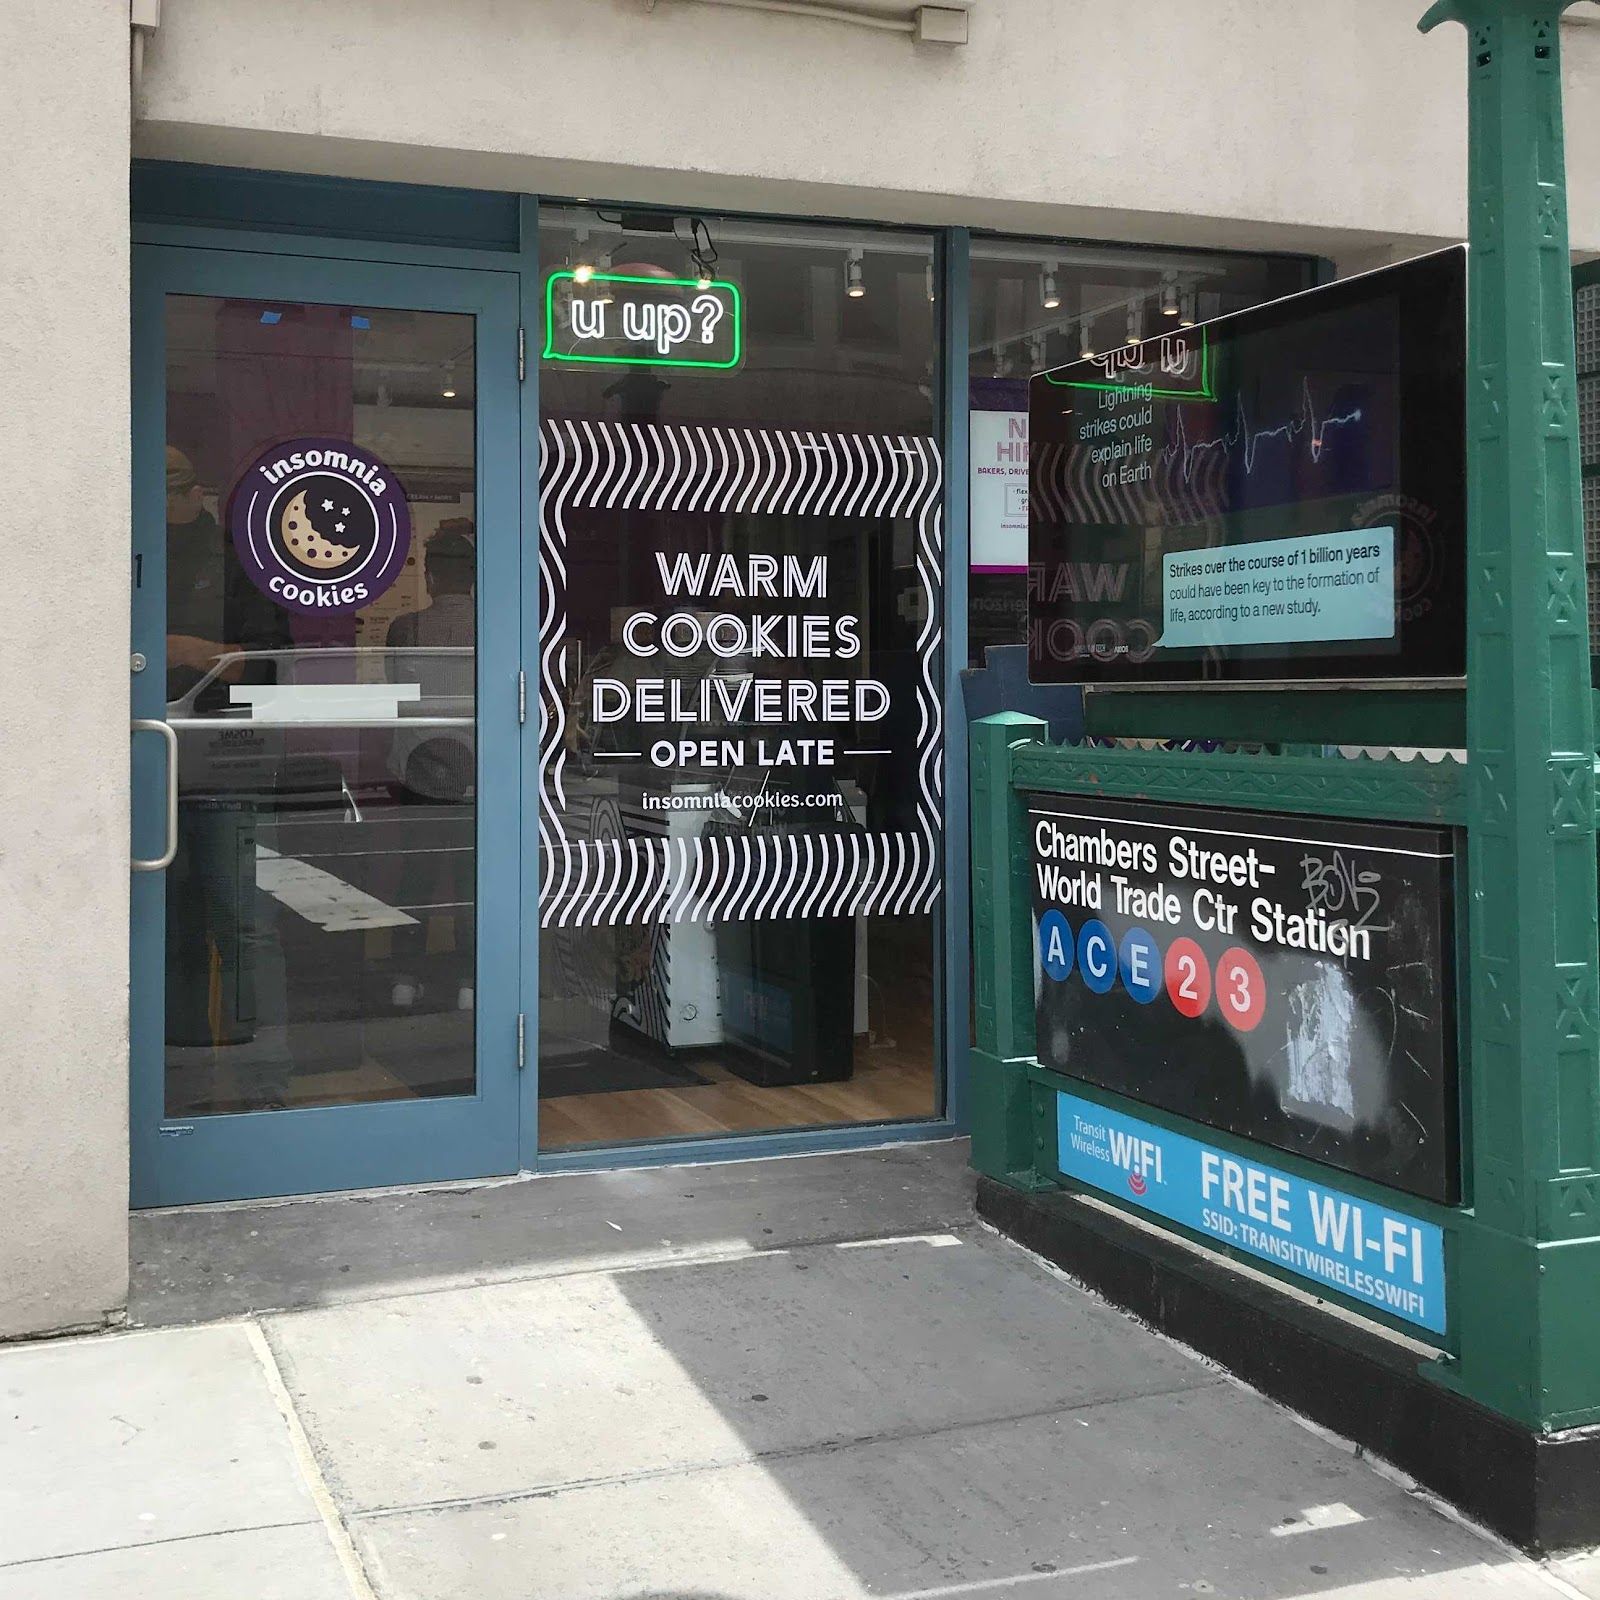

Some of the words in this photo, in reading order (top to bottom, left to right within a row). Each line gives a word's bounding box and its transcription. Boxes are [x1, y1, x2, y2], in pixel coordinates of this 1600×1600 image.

[572, 300, 604, 338] u
[623, 294, 724, 354] up?
[1098, 382, 1152, 411] Lightning
[1080, 418, 1116, 440] strikes
[1119, 405, 1152, 430] could
[1092, 441, 1132, 466] explain
[1134, 434, 1152, 454] life
[260, 450, 386, 496] insomnia
[1102, 472, 1117, 488] on
[1120, 462, 1152, 485] Earth
[656, 552, 827, 598] WARM
[1170, 563, 1202, 578] Strikes
[1205, 562, 1225, 574] over
[1228, 557, 1245, 572] the
[1248, 556, 1284, 570] course
[1288, 550, 1299, 566] of
[1300, 550, 1306, 565] 1
[1310, 546, 1343, 564] billion
[1346, 544, 1380, 564] years
[269, 576, 368, 607] cookies
[1170, 583, 1196, 600] could
[1199, 582, 1222, 597] have
[1224, 580, 1250, 596] been
[1253, 578, 1270, 596] key
[1274, 577, 1284, 591] to
[1286, 575, 1304, 590] the
[1307, 570, 1364, 589] formation
[1368, 567, 1380, 584] of
[1170, 607, 1186, 623] life,
[1188, 605, 1238, 622] according
[1240, 604, 1250, 618] to
[1253, 606, 1260, 616] a
[1262, 602, 1284, 616] new
[1287, 598, 1320, 616] study.
[622, 612, 860, 658] COOKIES
[592, 678, 891, 722] DELIVERED
[650, 740, 744, 767] OPEN
[758, 740, 834, 766] LATE
[642, 790, 844, 810] insomniacookies.com
[1035, 820, 1158, 874] Chambers
[1169, 836, 1276, 888] Street-
[1036, 863, 1101, 910] World
[1110, 874, 1182, 925] Trade
[1192, 888, 1238, 936] Ctr
[1251, 898, 1371, 961] Station
[1047, 925, 1066, 966] A
[1086, 936, 1107, 978] C
[1131, 943, 1150, 988] E
[1178, 955, 1198, 1001] 2
[1229, 966, 1252, 1013] 3
[1073, 1114, 1106, 1142] Transit
[1070, 1133, 1110, 1162] Wireless
[1201, 1151, 1292, 1232] FREE
[1309, 1190, 1424, 1285] WI-FI
[1202, 1208, 1238, 1240] SSID:
[1240, 1222, 1425, 1318] TRANSITWIRELESSWIFI
